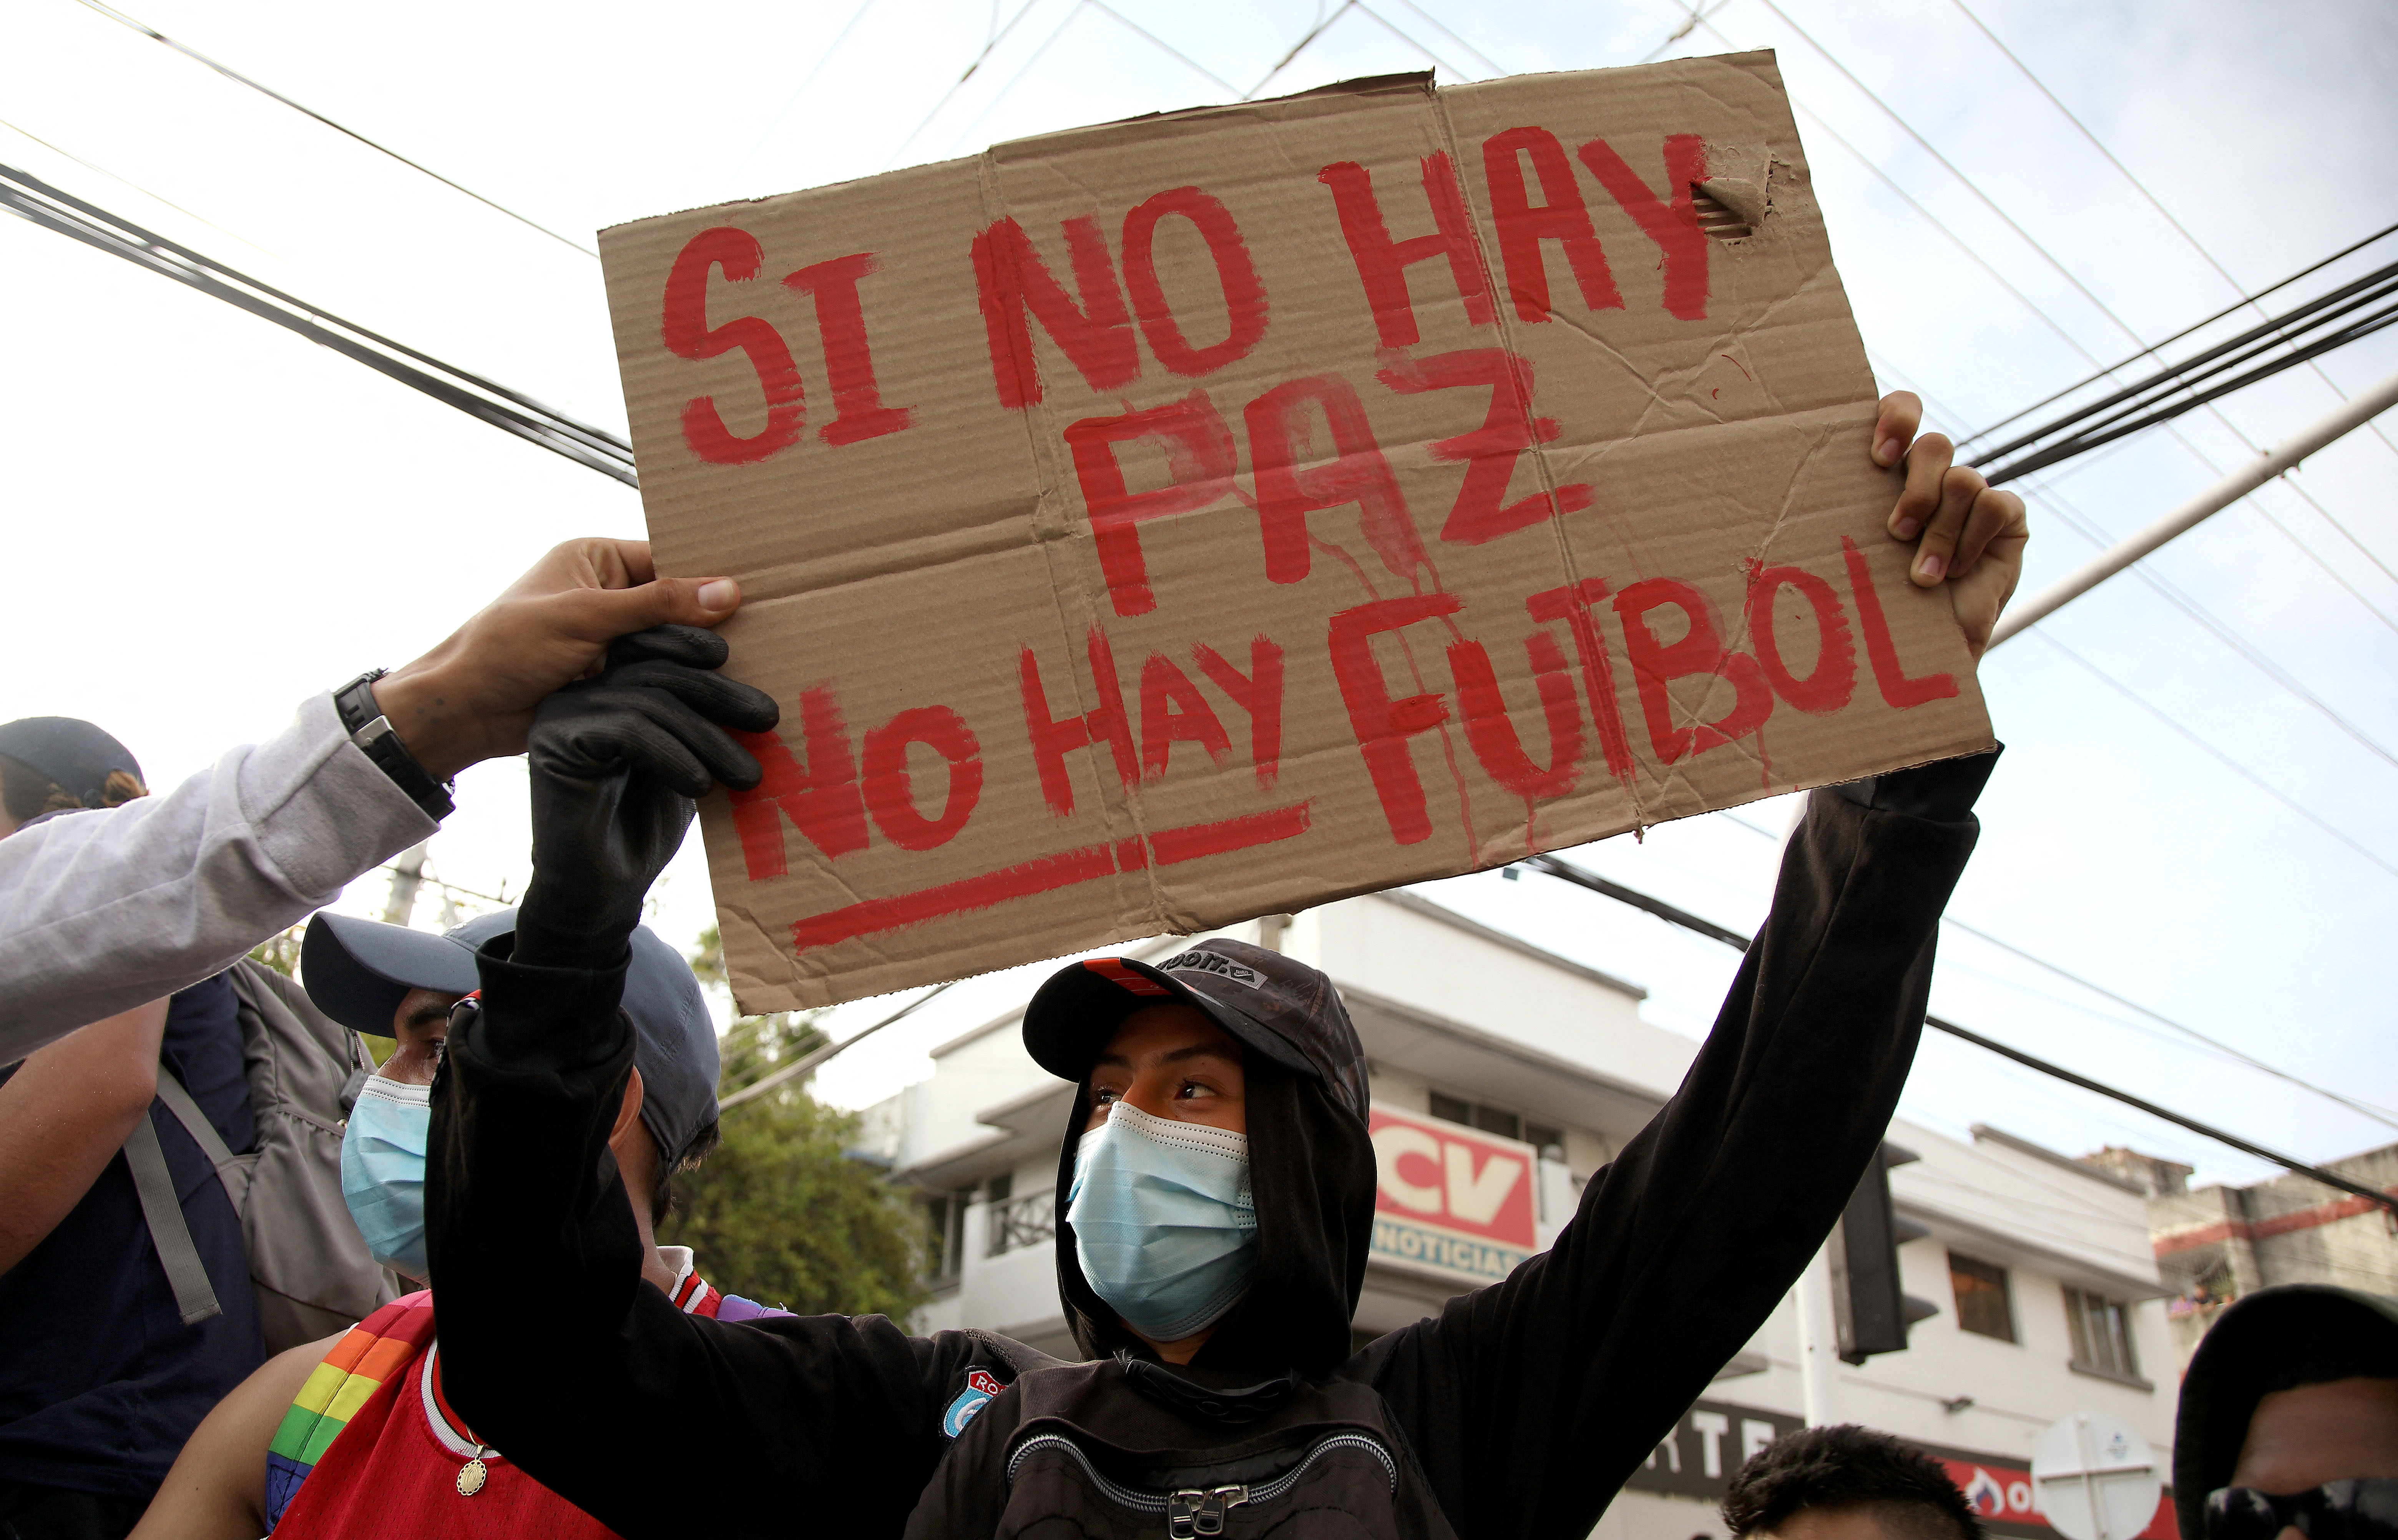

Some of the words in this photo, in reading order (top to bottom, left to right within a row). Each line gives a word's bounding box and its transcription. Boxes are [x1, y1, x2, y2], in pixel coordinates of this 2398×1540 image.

[662, 225, 921, 466] SI
[969, 185, 1270, 410] NO
[1317, 126, 1709, 349] HAY
[1063, 347, 1599, 617] PAZ
[720, 675, 983, 883] NO
[1015, 619, 1284, 817] HAY
[1327, 535, 1961, 845] FUTBOL
[1371, 1125, 1523, 1226] CV
[1373, 1223, 1521, 1279] NOTICIAS
[976, 1375, 1003, 1394] RO
